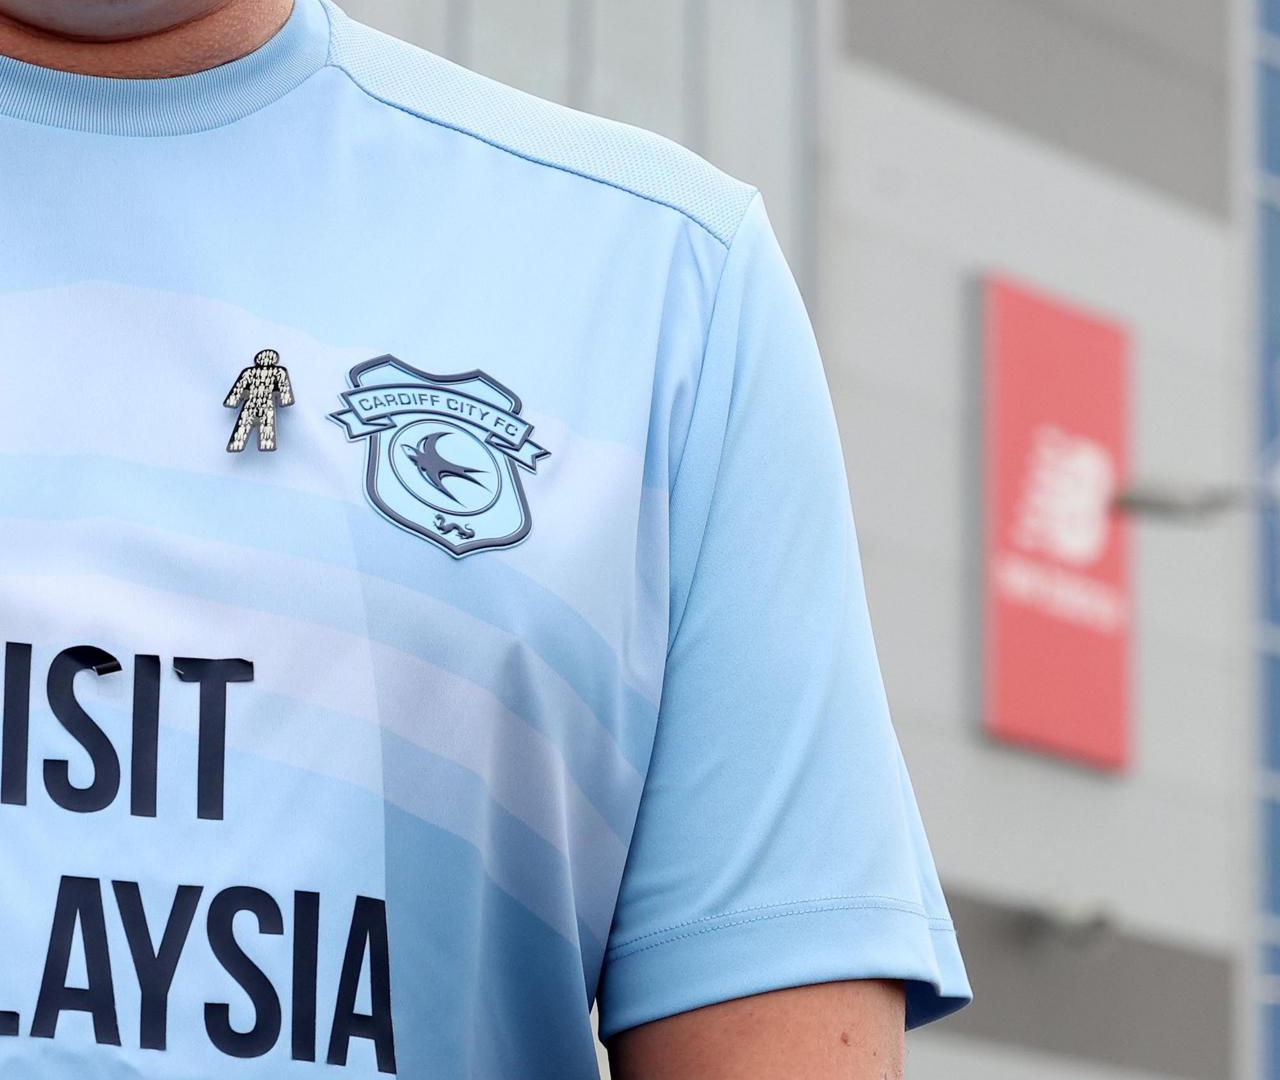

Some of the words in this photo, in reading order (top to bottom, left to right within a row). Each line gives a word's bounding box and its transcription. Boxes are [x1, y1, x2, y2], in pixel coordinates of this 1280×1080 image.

[359, 393, 440, 412] CARDIFF
[447, 398, 491, 421] CITY
[493, 417, 519, 436] FC
